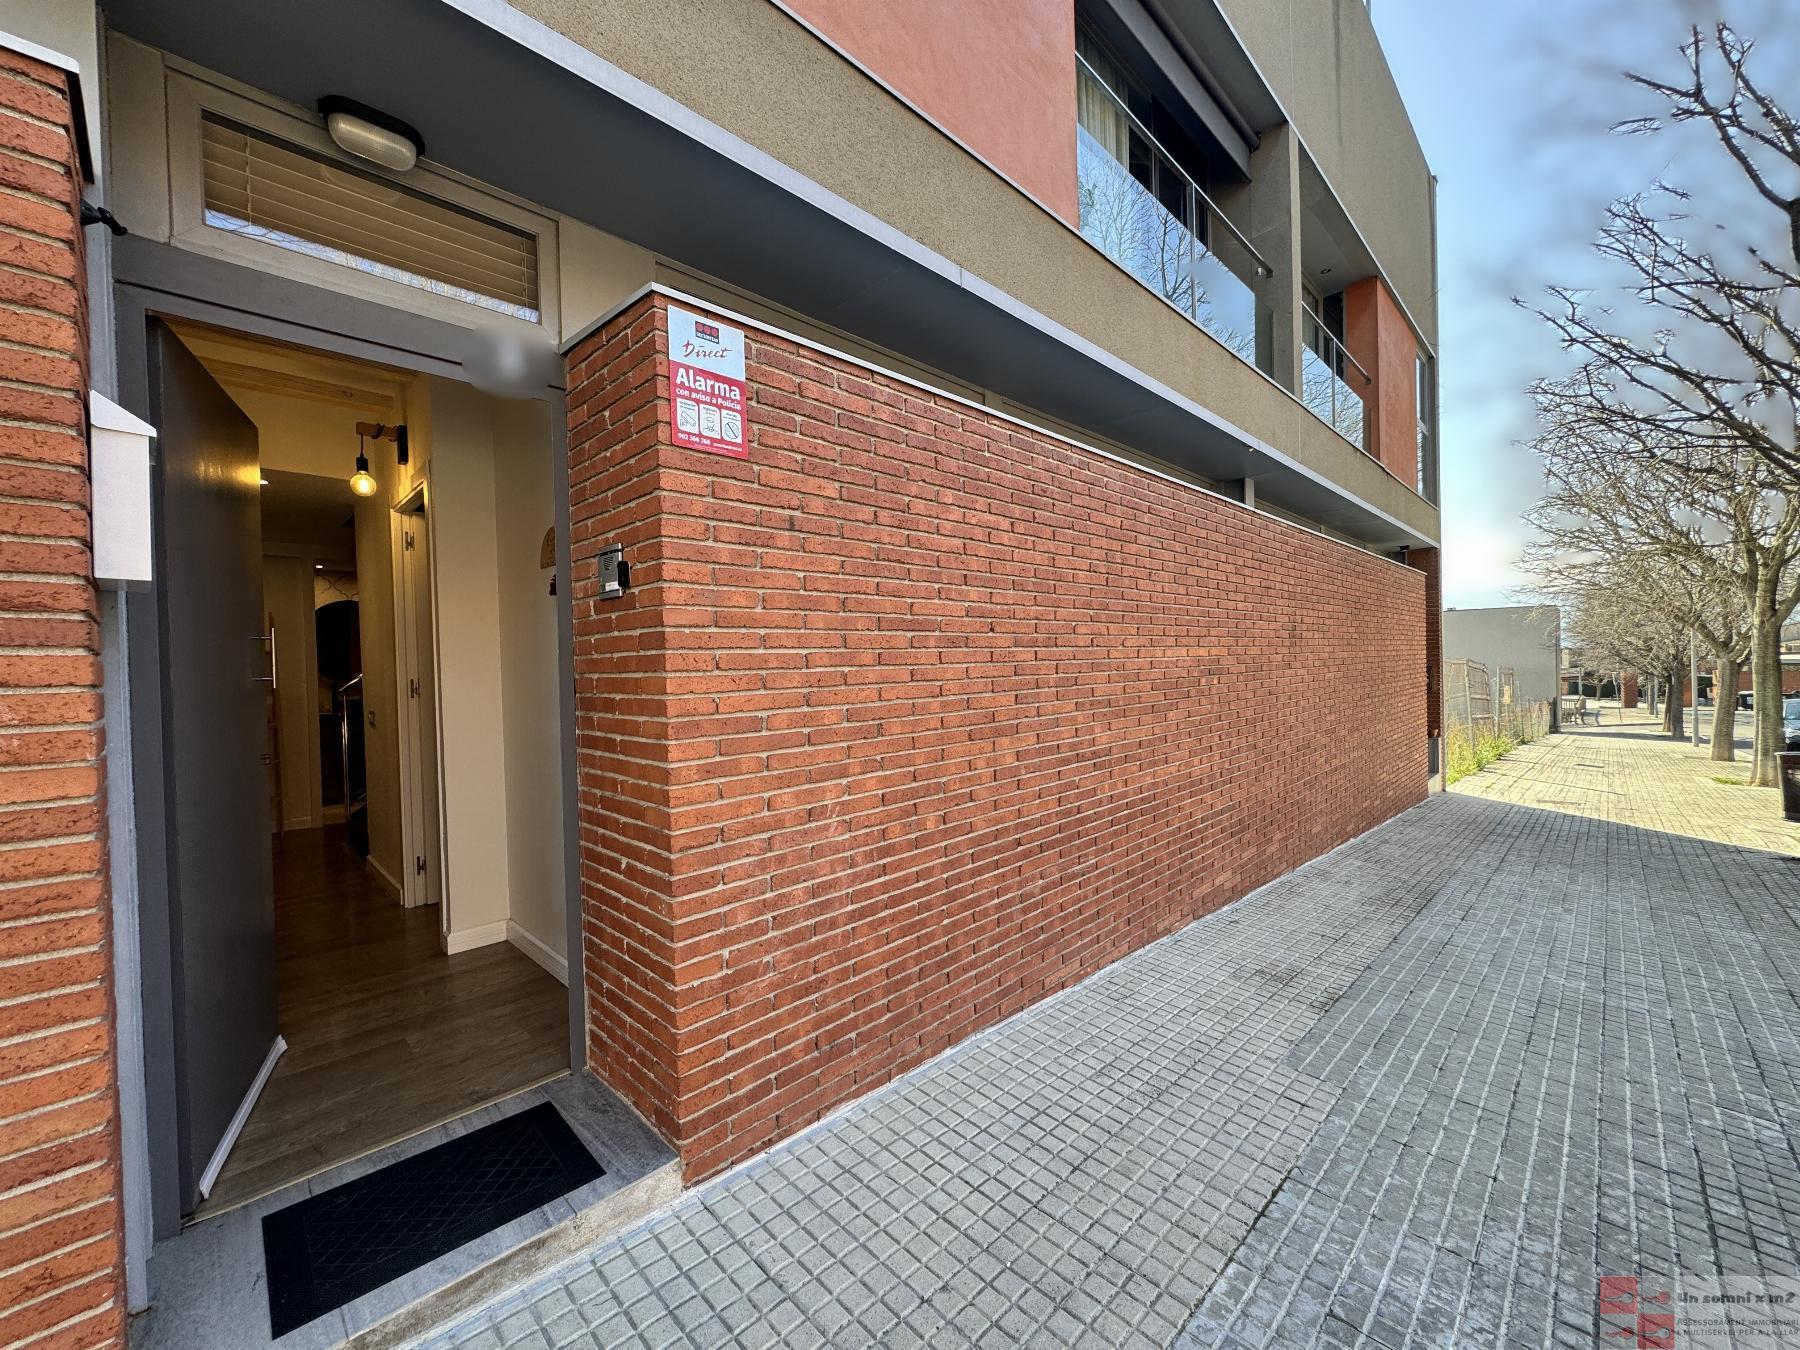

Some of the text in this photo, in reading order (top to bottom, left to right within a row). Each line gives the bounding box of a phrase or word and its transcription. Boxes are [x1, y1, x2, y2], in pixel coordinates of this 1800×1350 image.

[681, 340, 733, 359] Direct
[676, 367, 740, 400] Alarma
[676, 388, 689, 397] con
[691, 392, 711, 402] aviso
